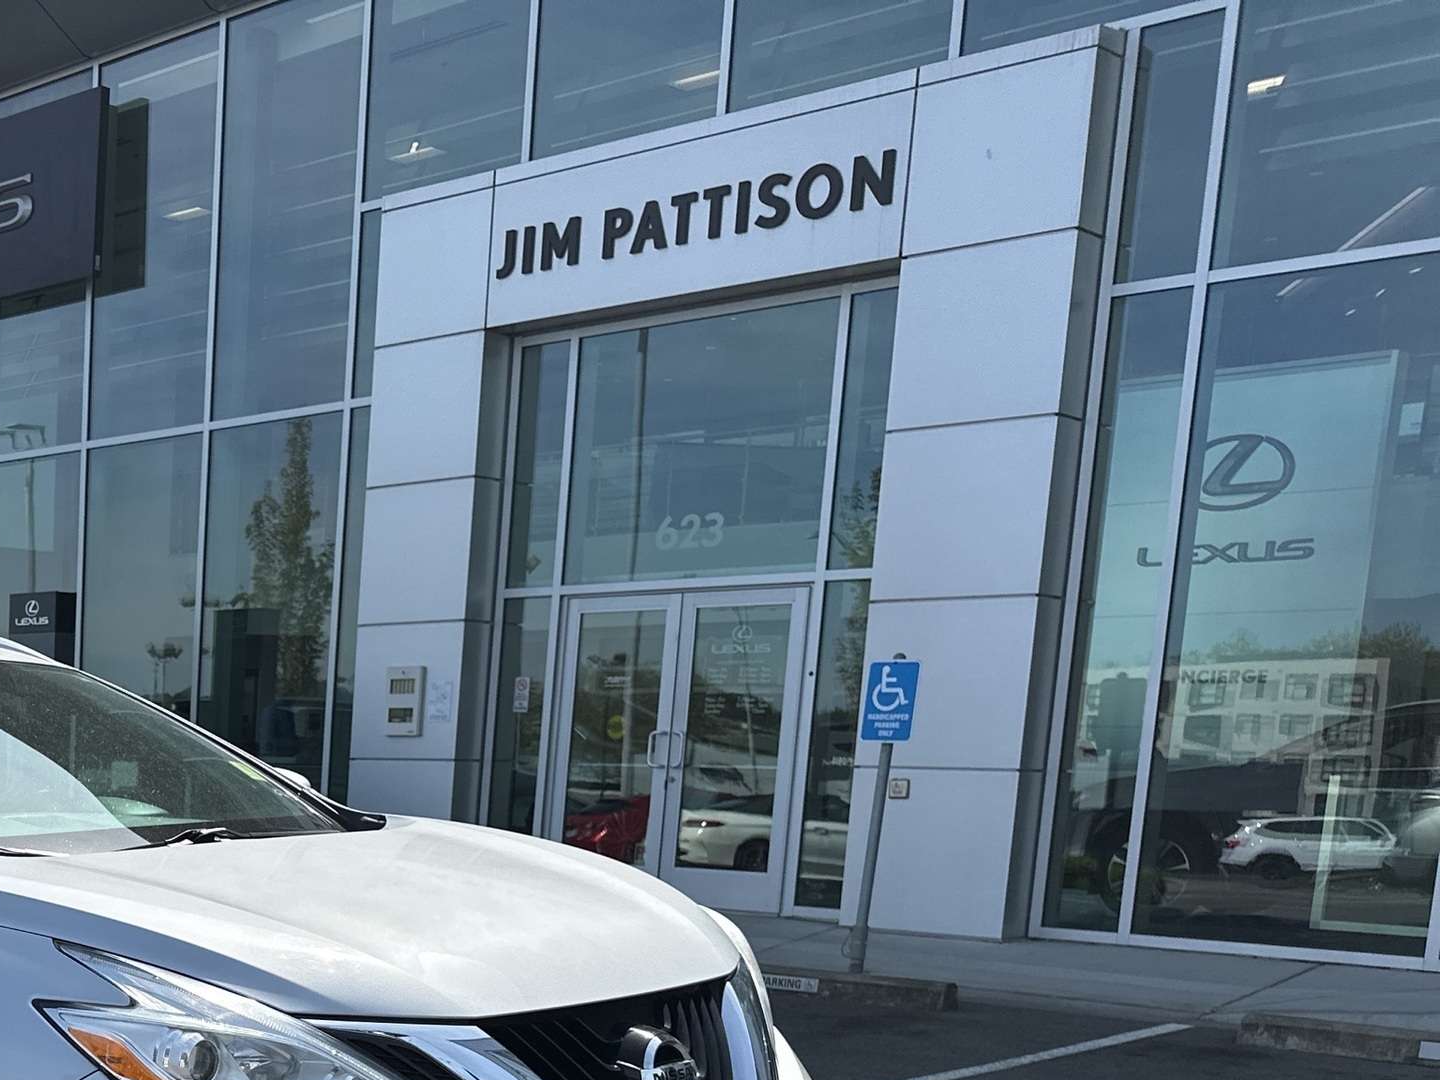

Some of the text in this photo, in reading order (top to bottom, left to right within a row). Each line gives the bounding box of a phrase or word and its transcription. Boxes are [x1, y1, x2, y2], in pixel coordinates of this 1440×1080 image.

[495, 148, 897, 280] JIM PATTISON
[656, 512, 725, 550] 623
[15, 616, 49, 626] LEXUS
[711, 643, 771, 654] LEXUS
[1180, 668, 1269, 684] NCIERGE
